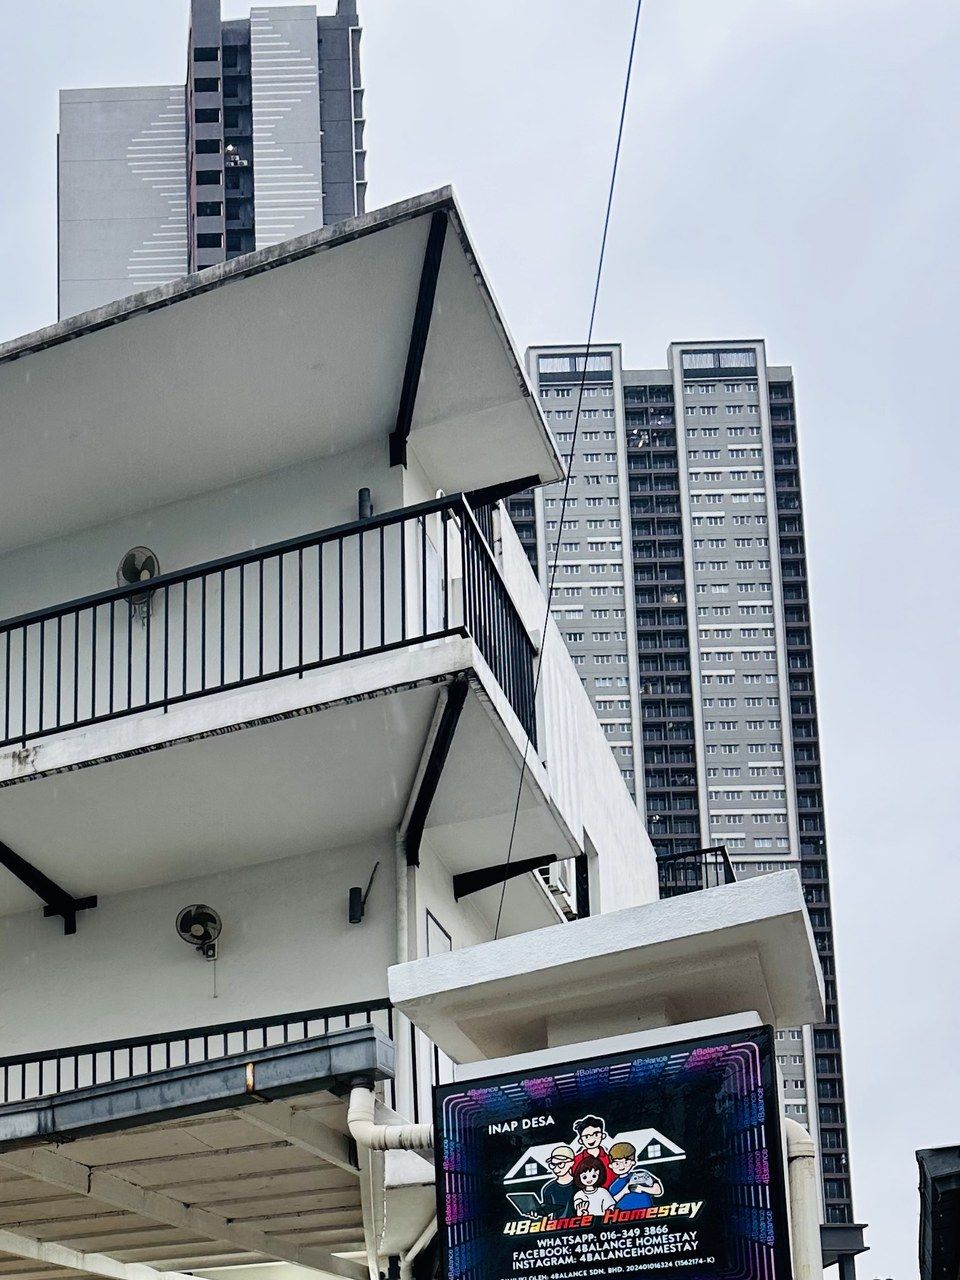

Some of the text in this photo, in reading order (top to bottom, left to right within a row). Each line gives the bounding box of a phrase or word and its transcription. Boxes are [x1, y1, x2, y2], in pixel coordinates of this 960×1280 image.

[488, 1116, 555, 1135] INAP DESA
[503, 1201, 704, 1236] 4Balance Homestay
[513, 1231, 697, 1261] FACEBOOK: 4BALANCE HOMESTAY
[537, 1224, 669, 1248] WHATSAPP: 016-349 3866
[512, 1241, 699, 1270] INSTAGRAM: 4BALANCEHOMESTAY
[550, 1270, 588, 1280] 4BALANCE
